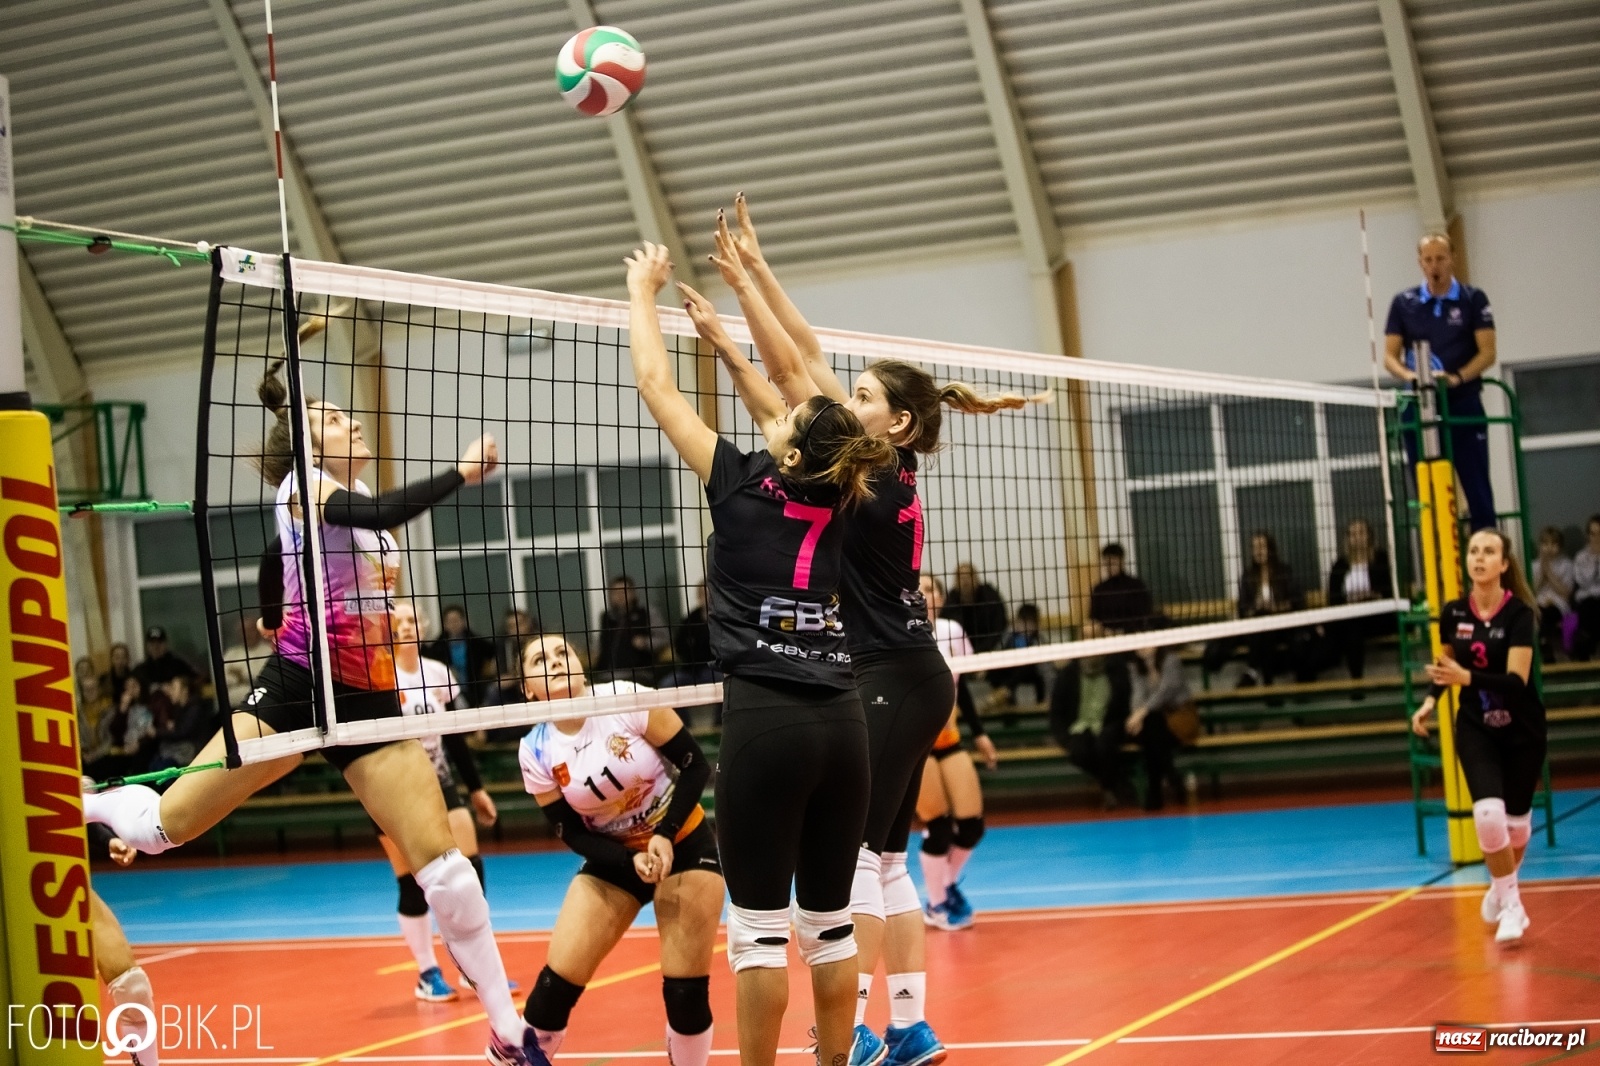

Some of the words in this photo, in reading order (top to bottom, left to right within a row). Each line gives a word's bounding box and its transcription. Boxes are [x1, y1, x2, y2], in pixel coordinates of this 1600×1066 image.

[783, 501, 833, 589] 7
[1471, 641, 1488, 668] 3
[1, 465, 102, 1042] PESMENPOL
[584, 766, 625, 801] 11
